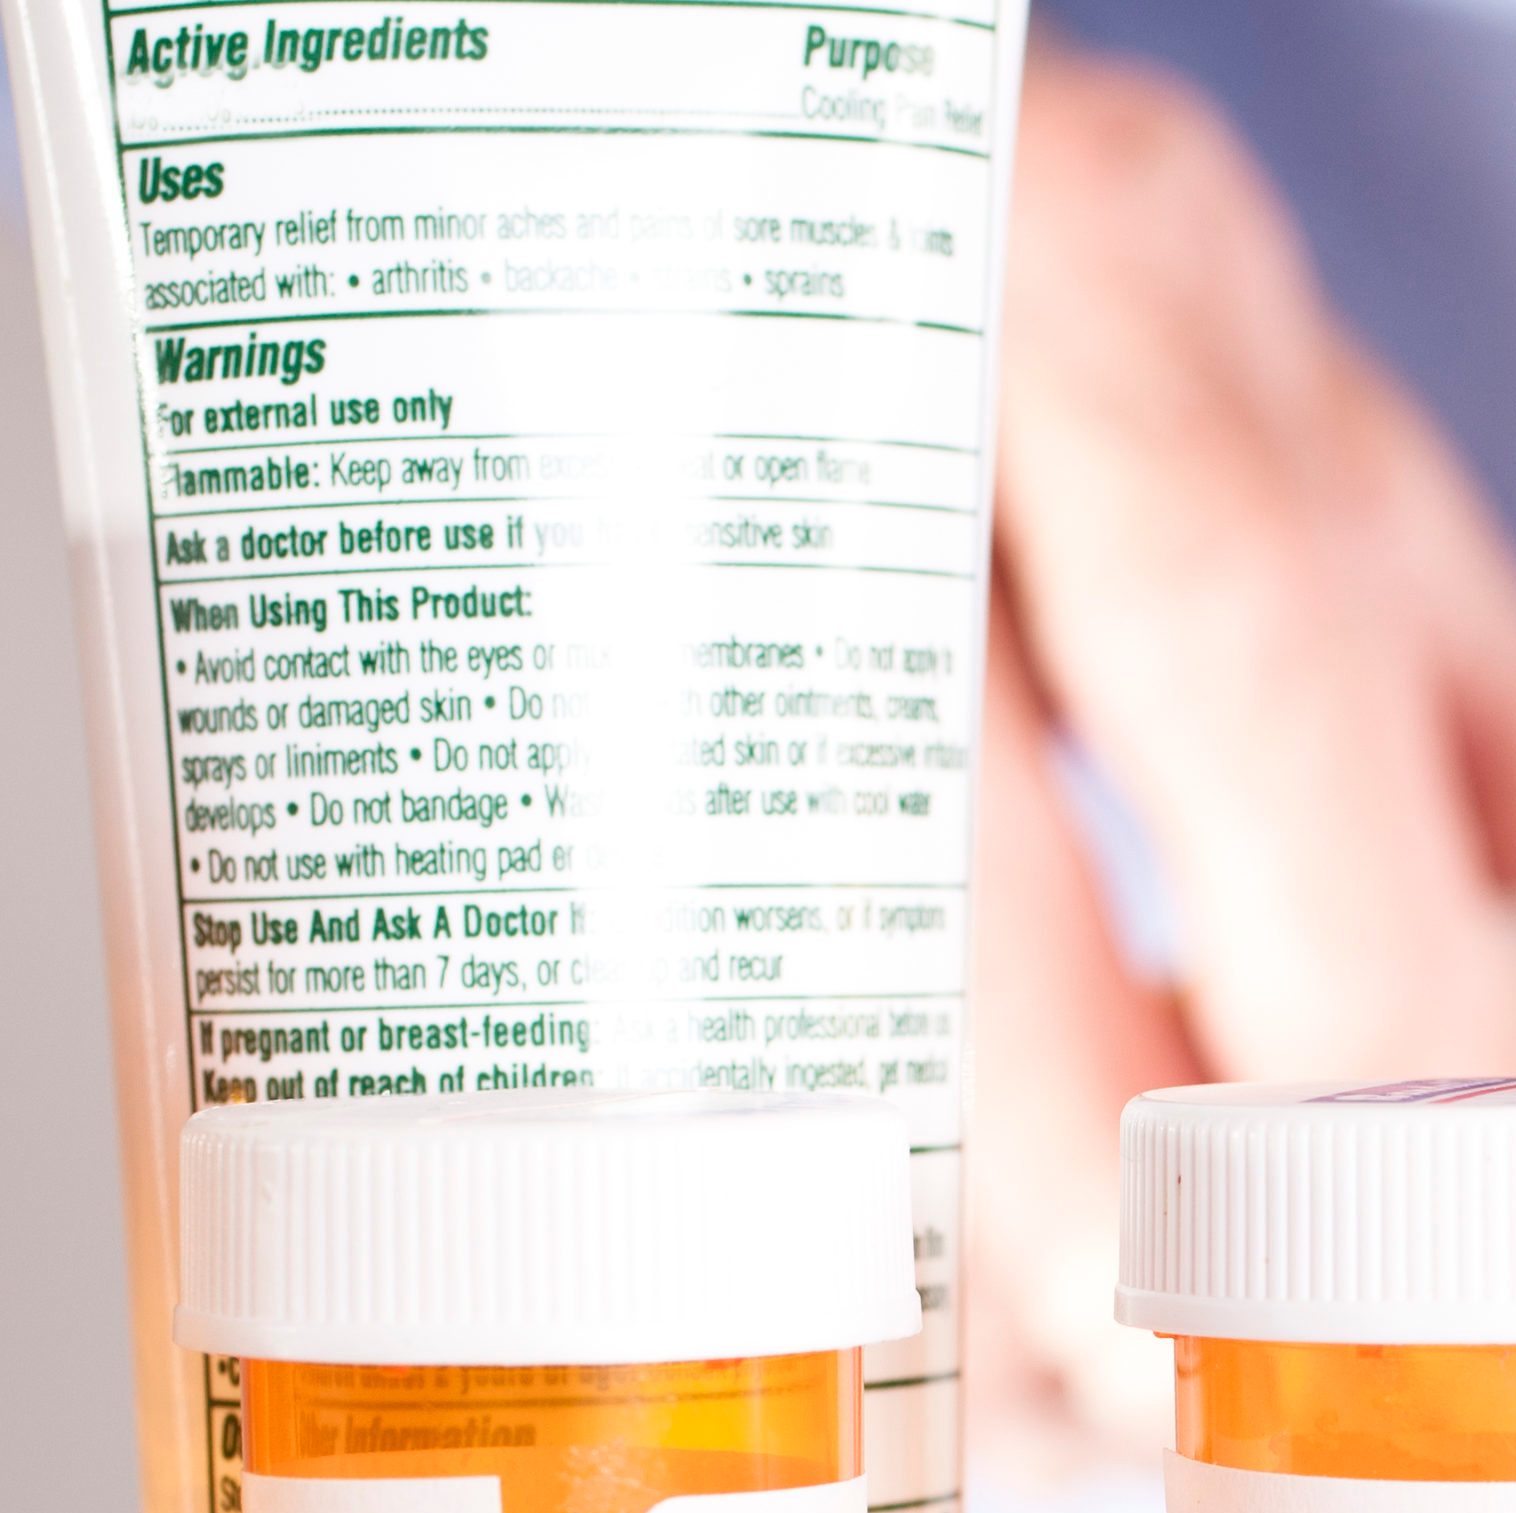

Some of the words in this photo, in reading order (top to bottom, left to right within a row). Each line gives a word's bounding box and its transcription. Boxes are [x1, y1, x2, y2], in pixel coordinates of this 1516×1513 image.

[127, 24, 248, 75] Active
[263, 17, 488, 73] Ingredients
[804, 25, 935, 80] Purpose
[139, 157, 225, 204] Uses
[140, 220, 264, 259] Temporary
[275, 209, 337, 247] relief
[347, 209, 404, 242] from
[415, 206, 487, 241] minor
[734, 214, 781, 242] sore
[145, 272, 266, 309] associated
[277, 269, 335, 298] with:
[372, 260, 468, 296] arthritis
[765, 268, 845, 299] sprains
[155, 333, 327, 384] Warnings
[158, 403, 194, 436] For
[205, 394, 317, 433] external
[330, 396, 380, 425] use
[394, 388, 452, 429] only
[330, 452, 391, 492] Keep
[402, 456, 463, 489] away
[474, 448, 530, 482] from
[724, 454, 743, 480] or
[756, 452, 807, 487] open
[167, 531, 206, 565] Ask
[217, 537, 229, 561] a
[242, 525, 327, 559] doctor
[341, 520, 431, 554] before
[446, 524, 494, 552] use
[508, 515, 523, 549] if
[792, 516, 832, 550] skin
[170, 598, 238, 634] When
[249, 593, 327, 632] Using
[339, 588, 400, 622] This
[412, 585, 533, 620] Product:
[195, 648, 255, 684] Avoid
[264, 643, 349, 681] contact
[360, 641, 409, 674] with
[421, 640, 457, 673] the
[468, 643, 523, 679] eyes
[533, 643, 554, 670] or
[178, 702, 257, 735] wounds
[268, 702, 288, 729] or
[300, 690, 410, 732] damaged
[421, 689, 472, 722] skin
[510, 686, 542, 721] Do
[711, 688, 764, 720] other
[181, 753, 246, 789] sprays
[256, 749, 276, 780] or
[287, 743, 397, 779] liniments
[434, 737, 467, 773] Do
[479, 737, 516, 769] not
[735, 733, 779, 767] skin
[789, 740, 807, 765] or
[185, 798, 276, 835] develops
[311, 791, 343, 827] Do
[353, 790, 391, 824] not
[402, 784, 508, 828] bandage
[705, 782, 751, 815] after
[761, 790, 797, 815] use
[209, 849, 236, 884] Do
[245, 848, 278, 882] not
[287, 852, 326, 880] use
[337, 844, 384, 878] with
[395, 841, 486, 881] heating
[498, 839, 541, 881] pad
[194, 912, 241, 953] Stop
[251, 911, 298, 945] Use
[310, 910, 359, 944] And
[373, 906, 422, 941] Ask
[434, 906, 451, 939] A
[465, 905, 558, 938] Doctor
[196, 962, 260, 1000] persist
[268, 960, 296, 995] for
[306, 963, 364, 993] more
[375, 957, 425, 992] than
[438, 955, 450, 986] 7
[462, 959, 527, 995] days,
[537, 959, 559, 986] or
[729, 953, 783, 982] recur
[201, 1021, 213, 1055] If
[222, 1018, 330, 1062] pregnant
[341, 1024, 369, 1053] or
[765, 1006, 880, 1049] professional
[268, 1069, 303, 1101] out
[315, 1068, 338, 1099] of
[350, 1067, 426, 1096] reach
[440, 1065, 465, 1093] of
[345, 1414, 536, 1453] Information
